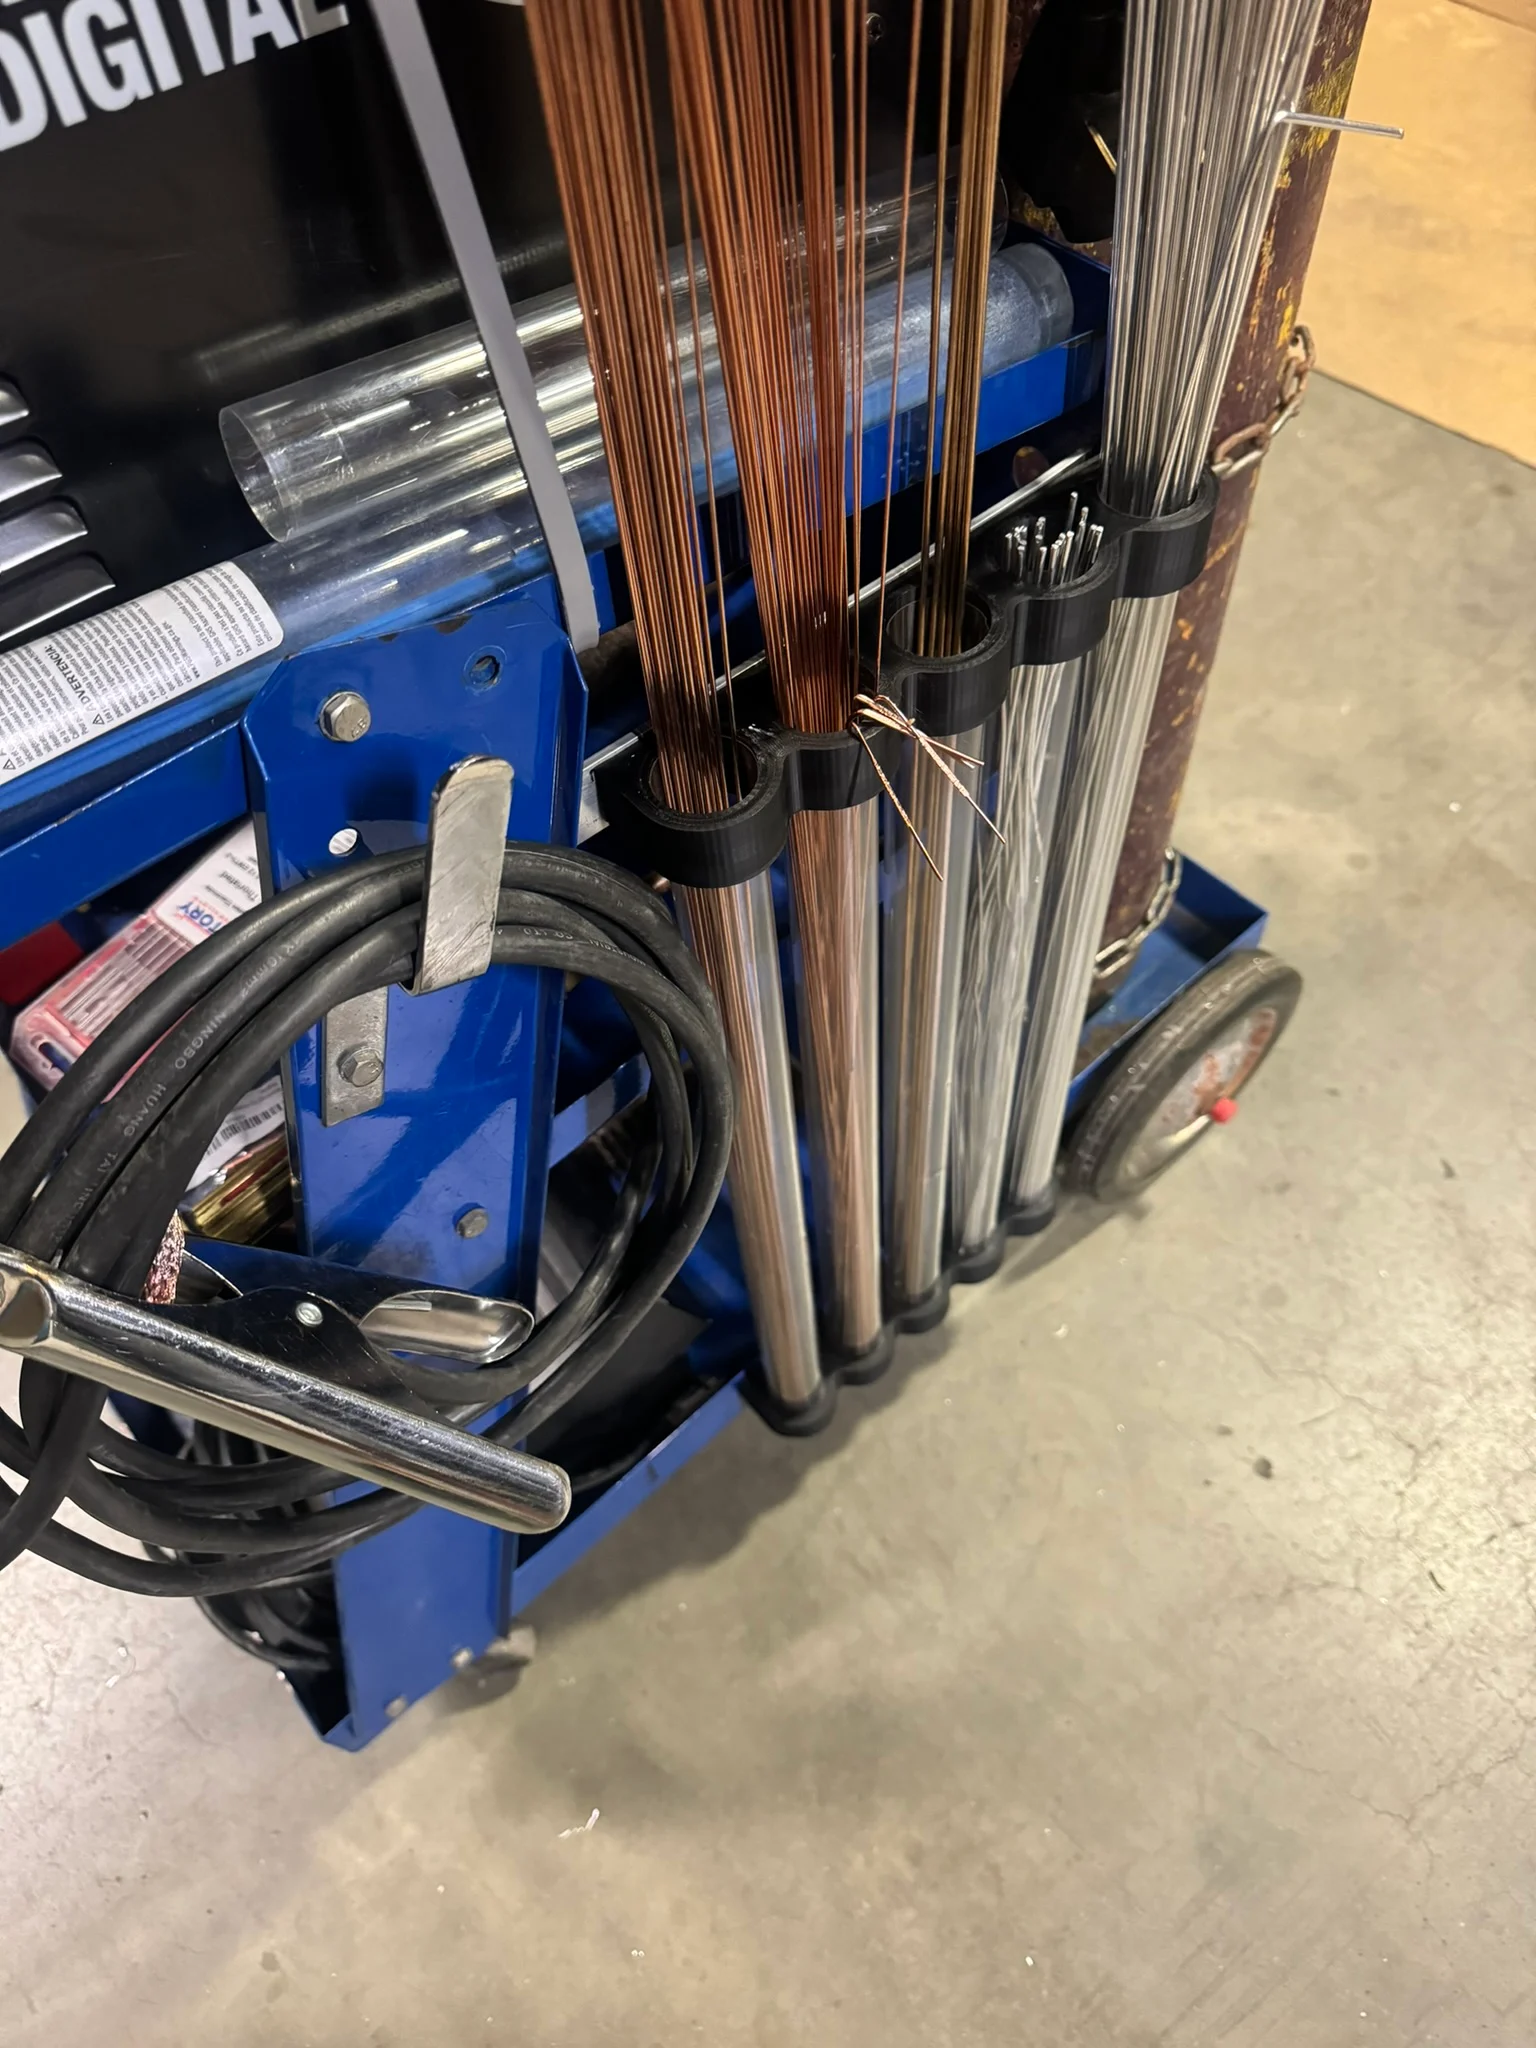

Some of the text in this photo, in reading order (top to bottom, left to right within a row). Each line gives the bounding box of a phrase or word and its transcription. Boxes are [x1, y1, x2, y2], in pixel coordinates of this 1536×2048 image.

[0, 0, 349, 150] DIGITAL
[45, 645, 95, 710] ADVERTENCIA:
[174, 1011, 227, 1070] NINGBO
[122, 1083, 168, 1138] HUANG
